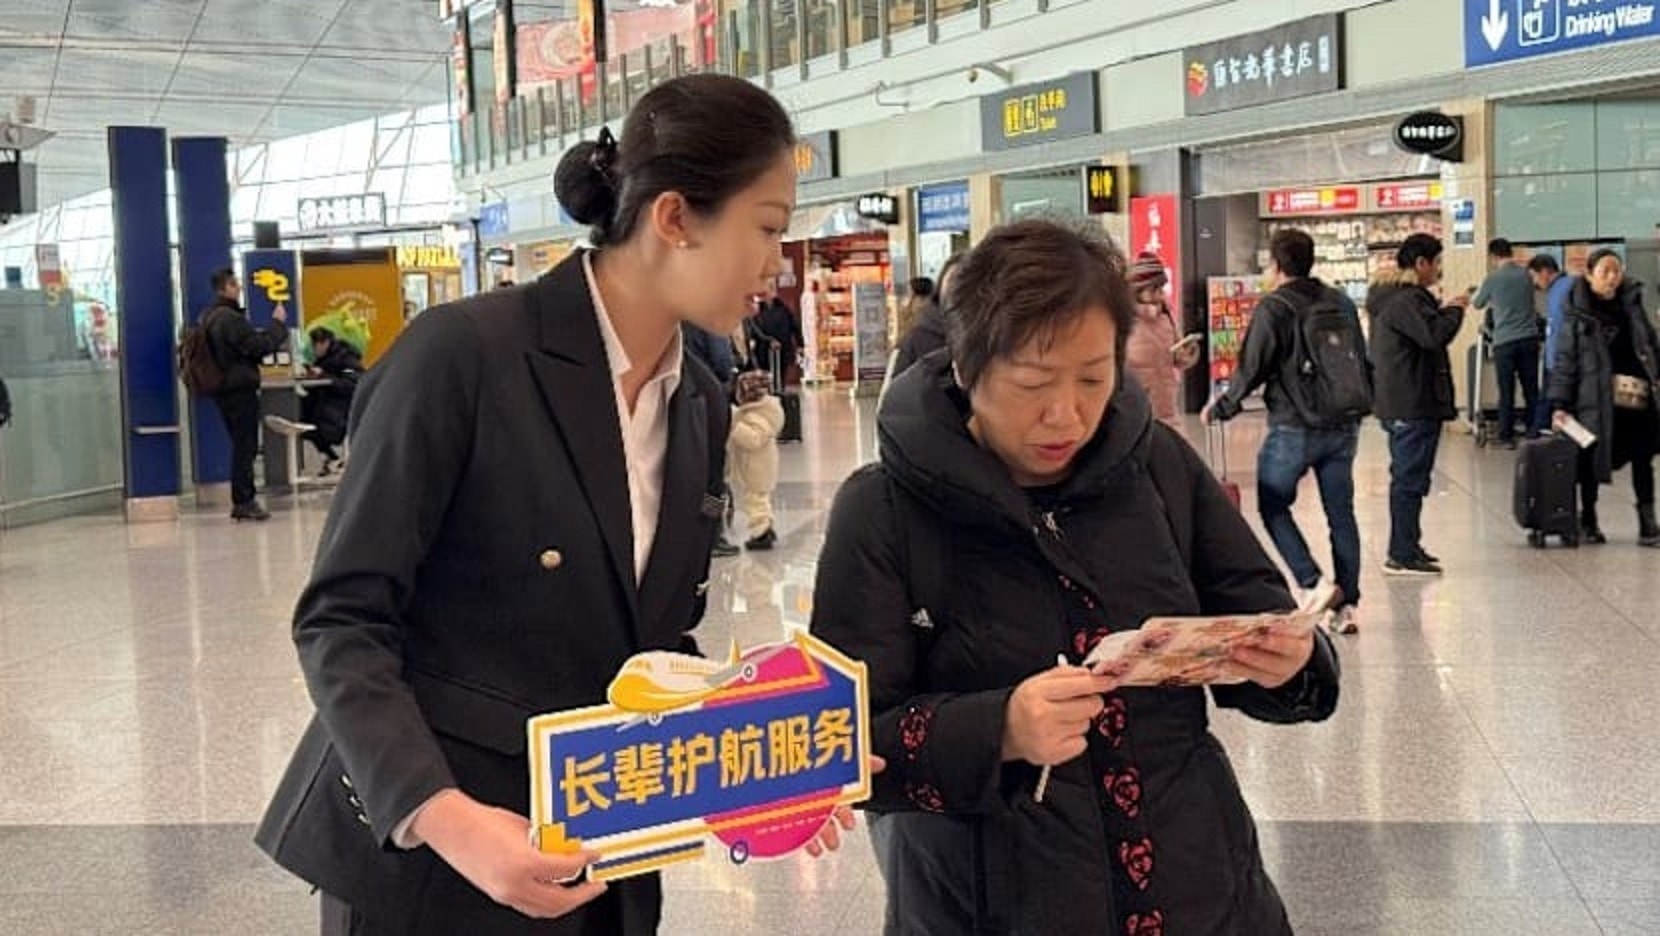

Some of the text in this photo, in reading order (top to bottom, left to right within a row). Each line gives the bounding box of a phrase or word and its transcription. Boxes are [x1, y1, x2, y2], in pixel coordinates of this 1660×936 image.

[1565, 4, 1654, 37] Drinking Water
[560, 707, 856, 817] 长辈护航服务
